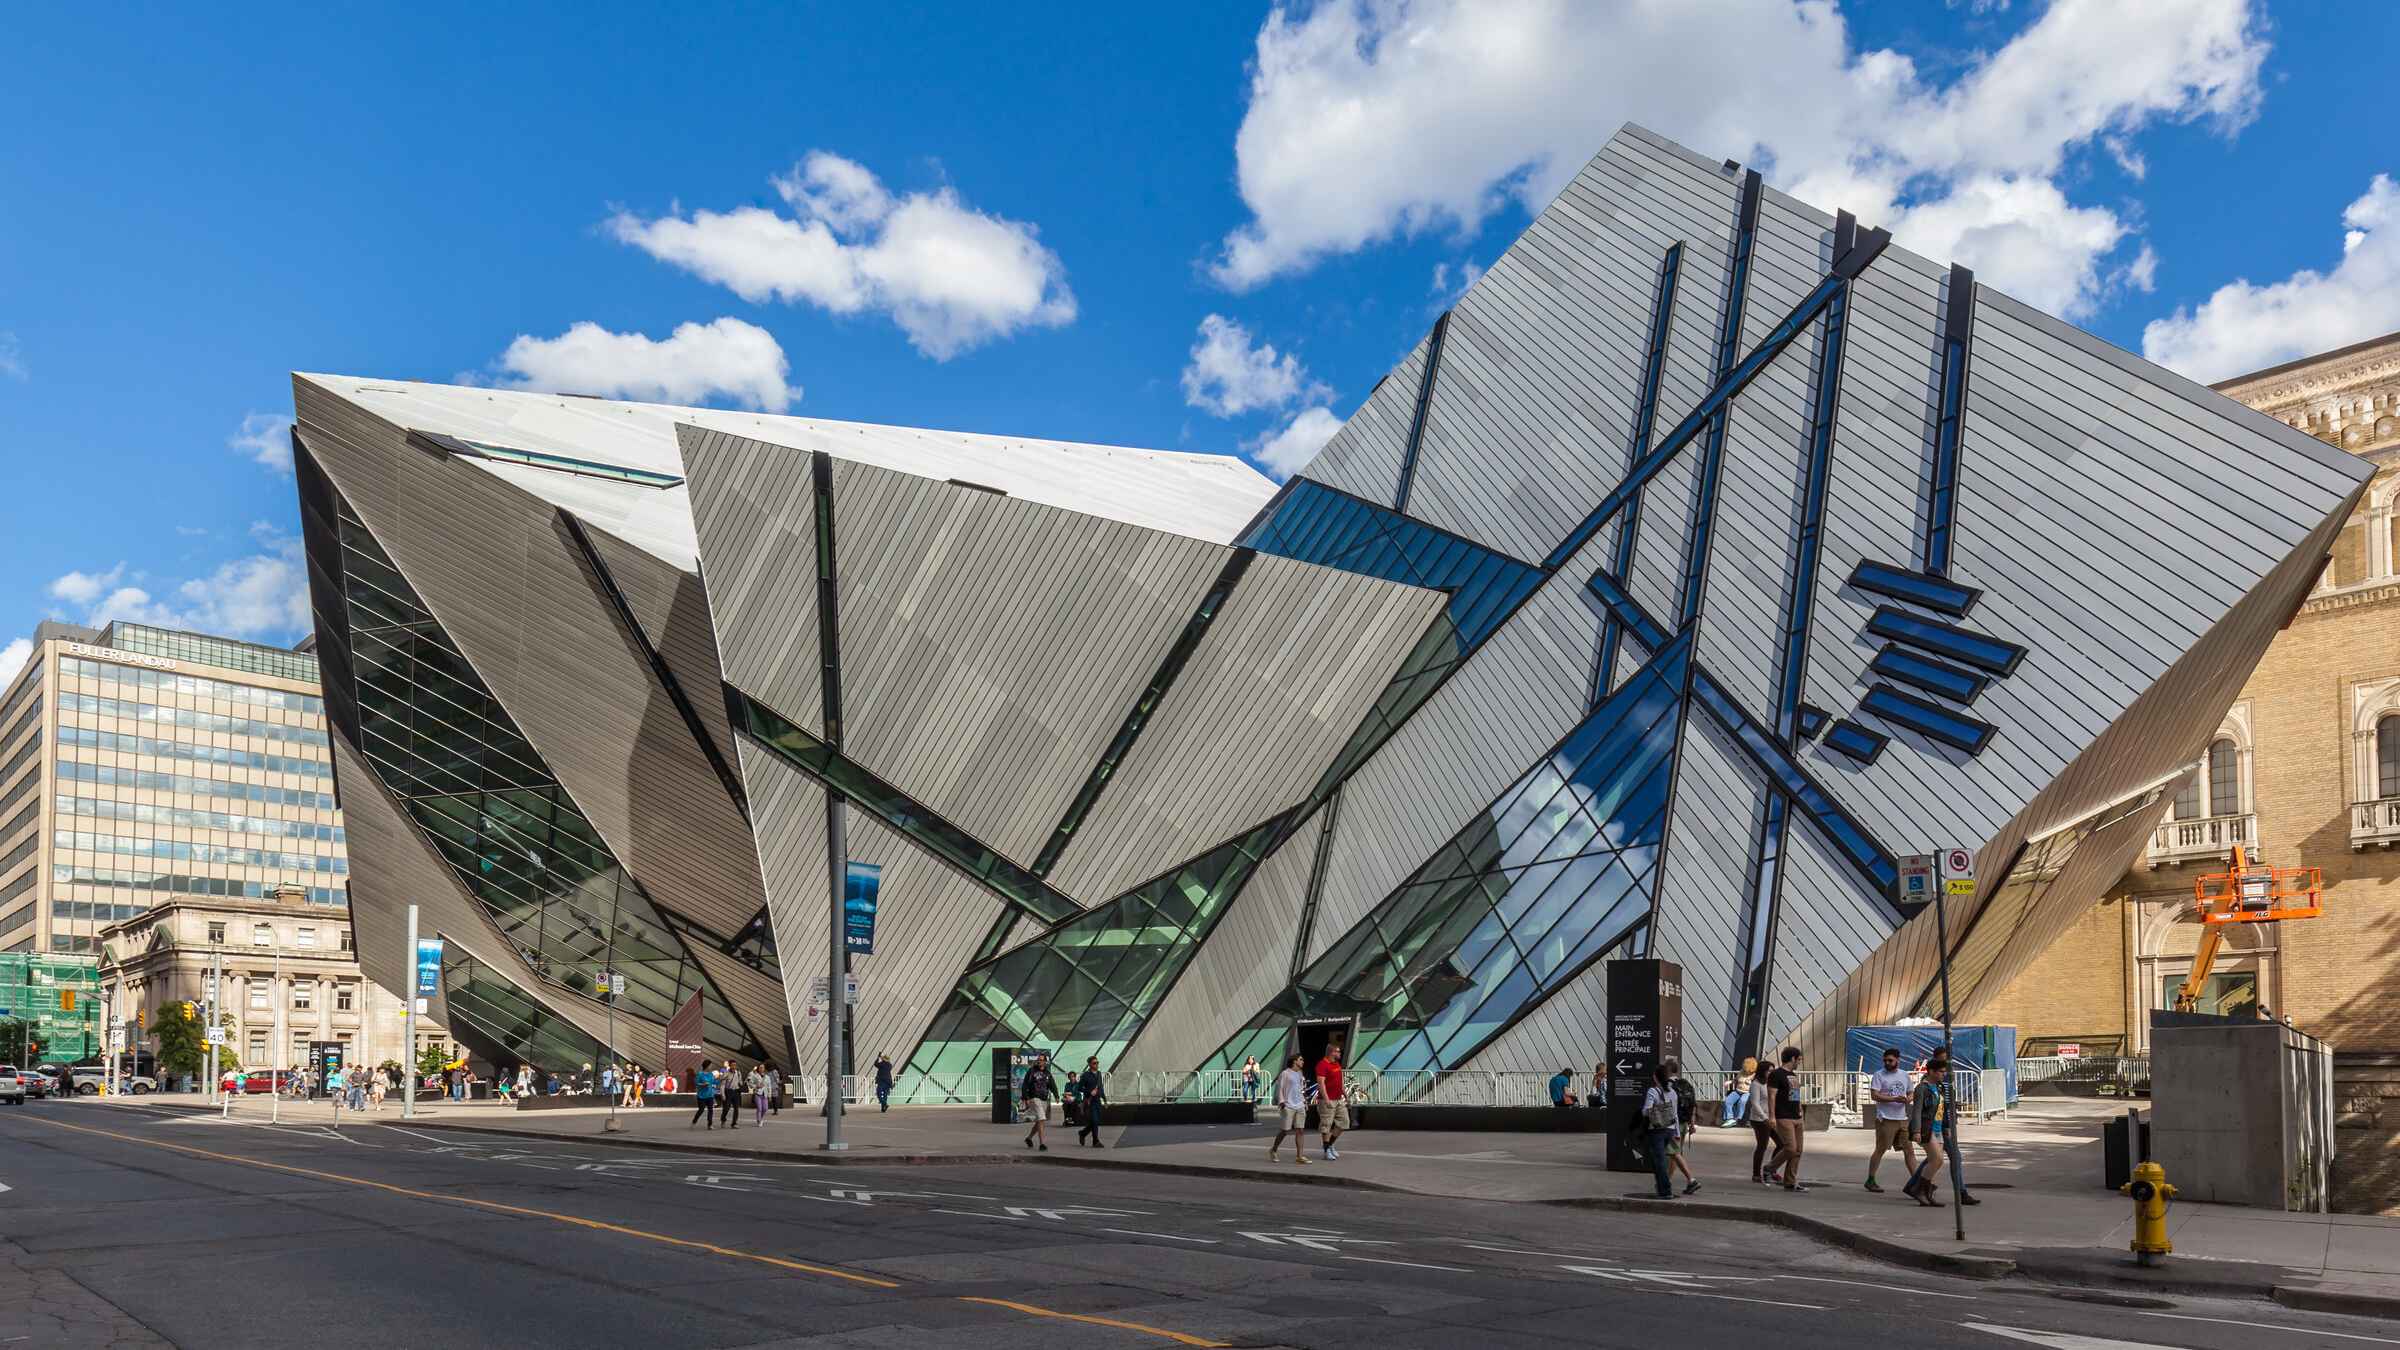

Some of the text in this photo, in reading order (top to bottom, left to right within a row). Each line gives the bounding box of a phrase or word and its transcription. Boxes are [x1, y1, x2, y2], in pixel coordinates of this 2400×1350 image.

[121, 651, 177, 670] LANDAU
[1615, 1030, 1652, 1038] ENTRANCE
[1615, 1038, 1640, 1047] ENTRÉE
